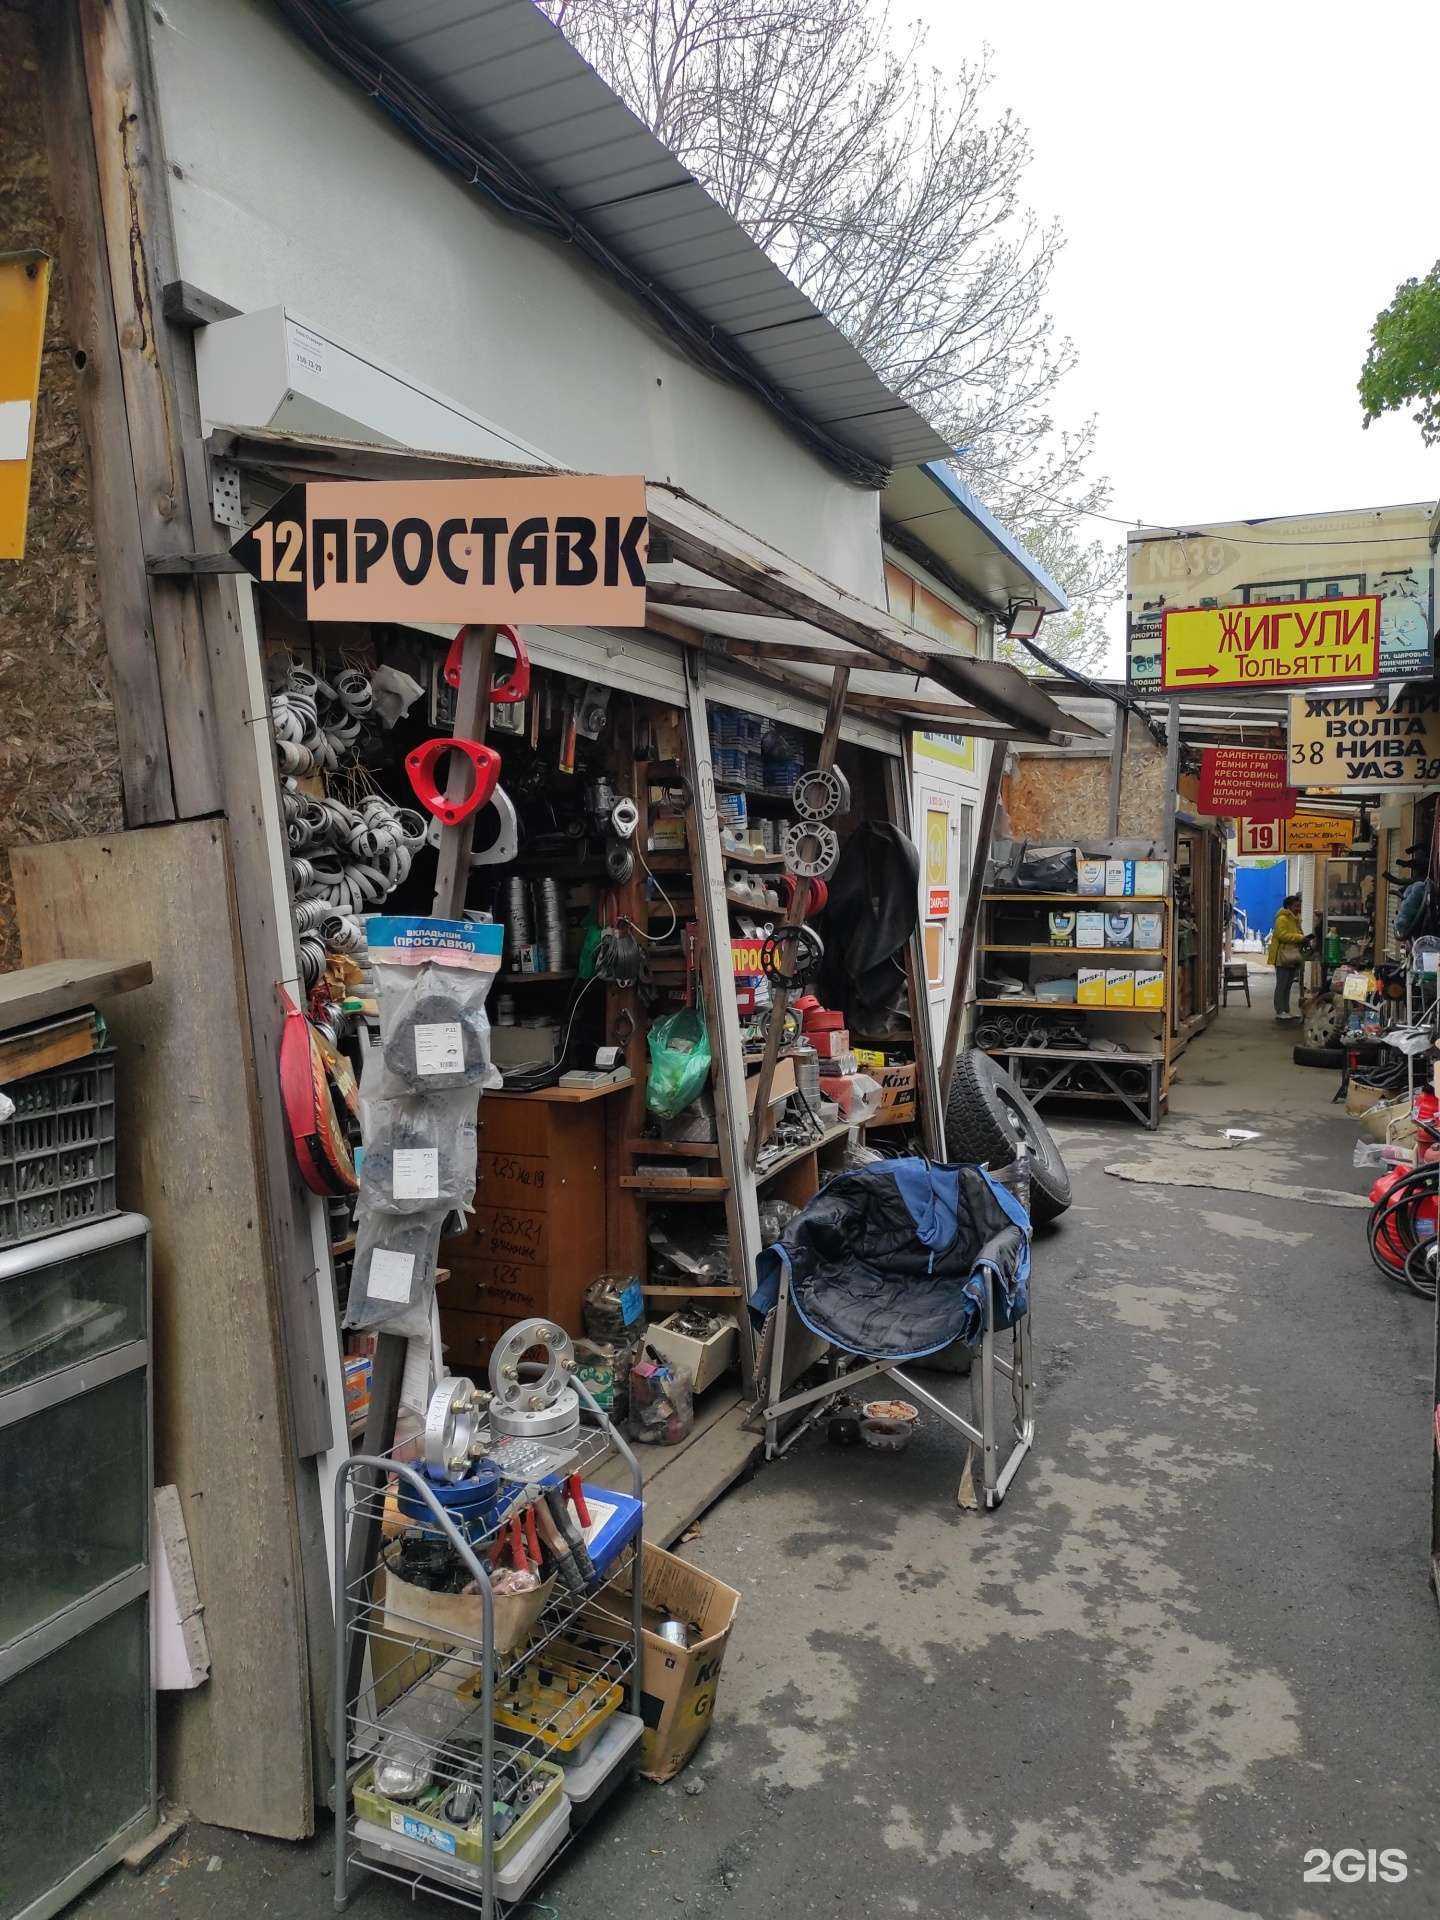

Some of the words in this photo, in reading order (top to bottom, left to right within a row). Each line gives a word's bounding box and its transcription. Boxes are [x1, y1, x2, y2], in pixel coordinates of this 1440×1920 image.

[252, 520, 303, 582] 12
[312, 516, 648, 594] ПРОСТАВК
[1218, 607, 1370, 653] ЖИГУЛИ
[1326, 717, 1427, 738] ВОЛГА
[1291, 741, 1325, 765] 38
[1336, 739, 1427, 759] НИВА
[1215, 760, 1248, 769] РЕМНИ
[1345, 760, 1405, 779] УАЗ
[1214, 770, 1279, 780] КРЕСТОВИНЫ
[1213, 779, 1283, 789] НАКОНЕЧНИКИ
[1213, 788, 1253, 797] ШЛАНГИ
[1212, 797, 1247, 806] ВТУЛКИ
[1248, 825, 1273, 849] 19
[406, 929, 461, 940] ВКЛАДЫШИ
[393, 936, 476, 952] (ПРОСТАВКИ)
[882, 1073, 911, 1087] Kixx
